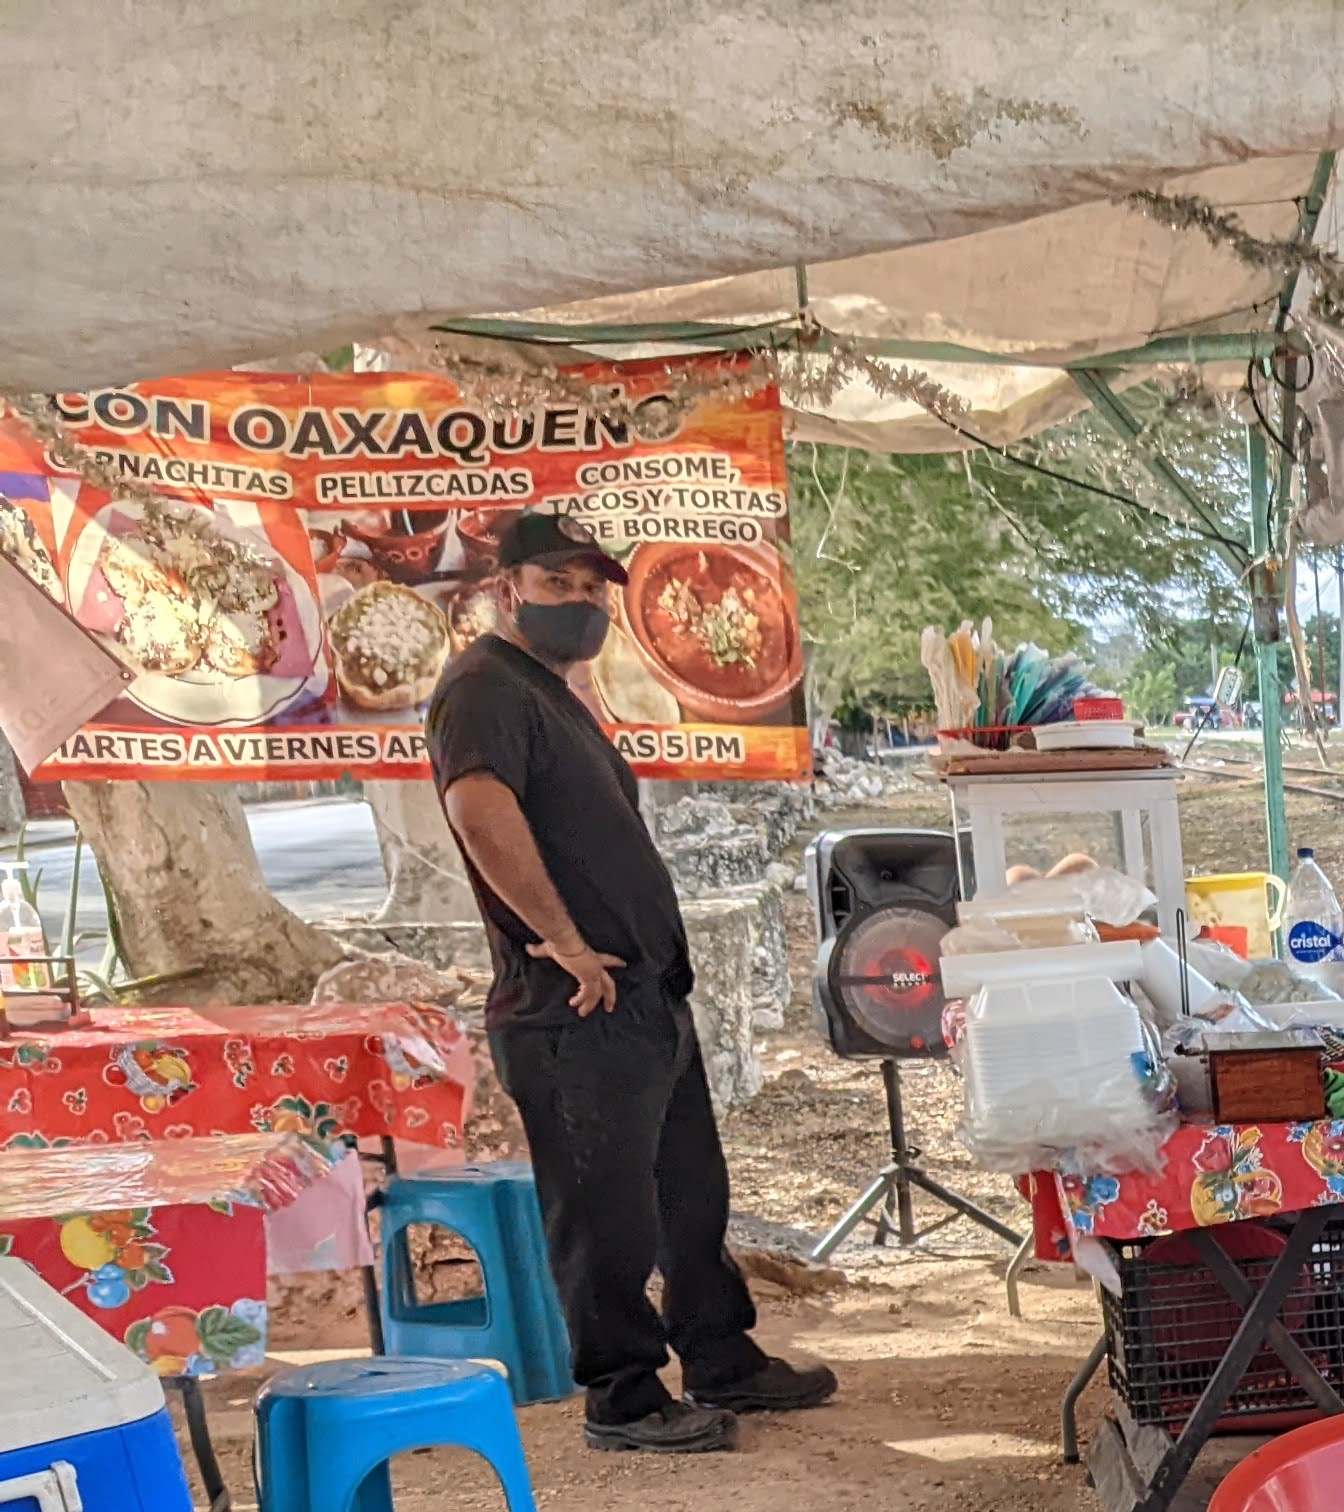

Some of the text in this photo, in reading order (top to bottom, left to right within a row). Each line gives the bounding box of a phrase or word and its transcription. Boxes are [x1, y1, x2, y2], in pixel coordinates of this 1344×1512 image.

[49, 448, 289, 496] RNACHITAS
[581, 457, 737, 486] CONSOME,
[321, 472, 528, 498] PELLIZCADAS
[547, 488, 782, 514] TACOS Y TORTAS
[624, 518, 757, 543] BORREGO
[193, 736, 220, 761] A
[223, 735, 376, 760] VIERNES
[618, 734, 656, 758] AS
[666, 735, 684, 758] 5
[694, 735, 741, 759] PM
[1290, 934, 1331, 949] cristal
[892, 972, 926, 982] SELECT
